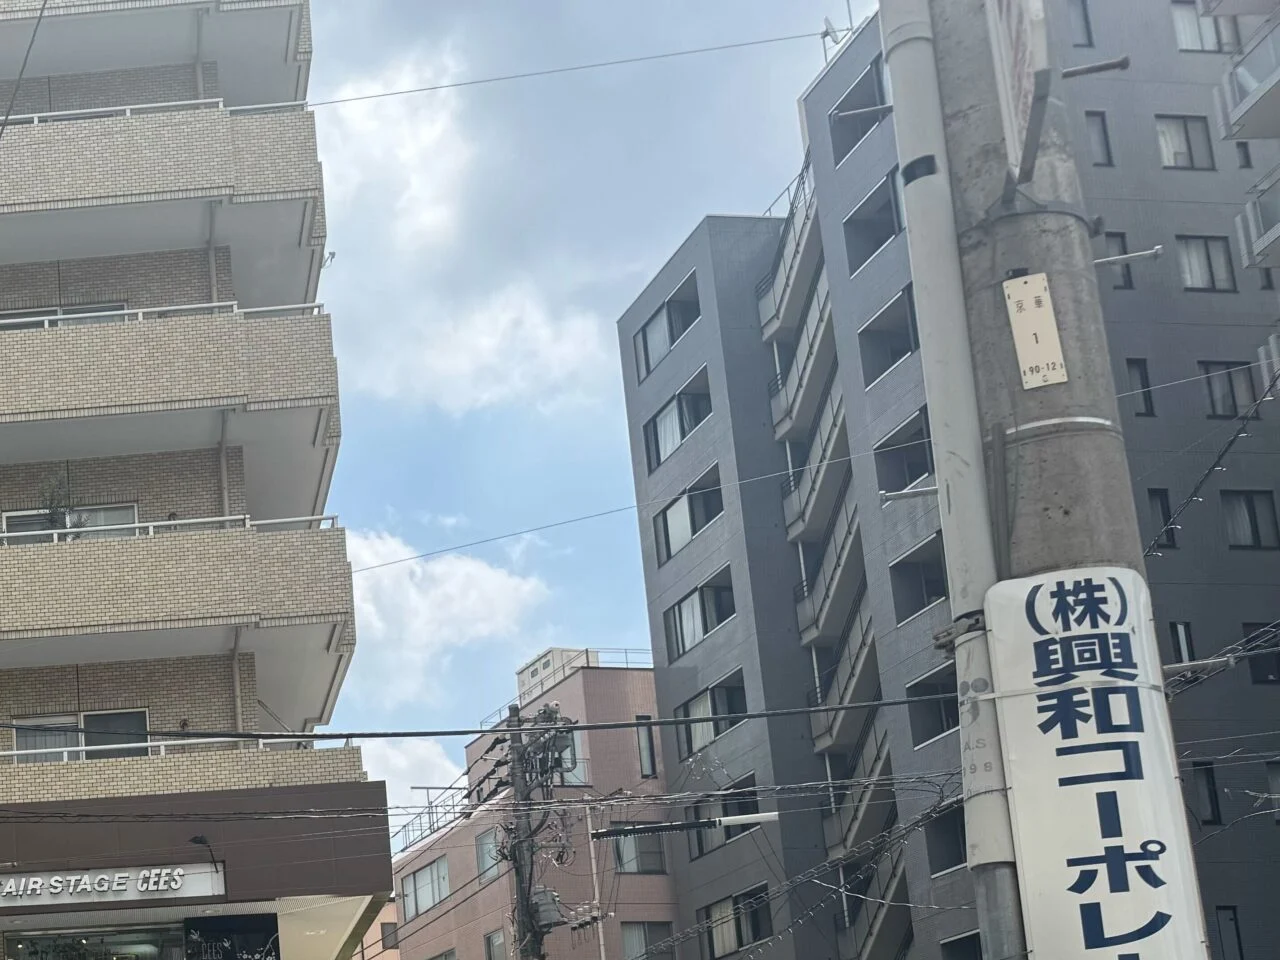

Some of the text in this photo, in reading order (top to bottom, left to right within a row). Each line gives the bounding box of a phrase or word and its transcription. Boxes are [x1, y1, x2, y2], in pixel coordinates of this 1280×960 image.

[1029, 361, 1057, 376] 90-12
[50, 872, 129, 895] STAGE
[137, 868, 184, 893] CEES
